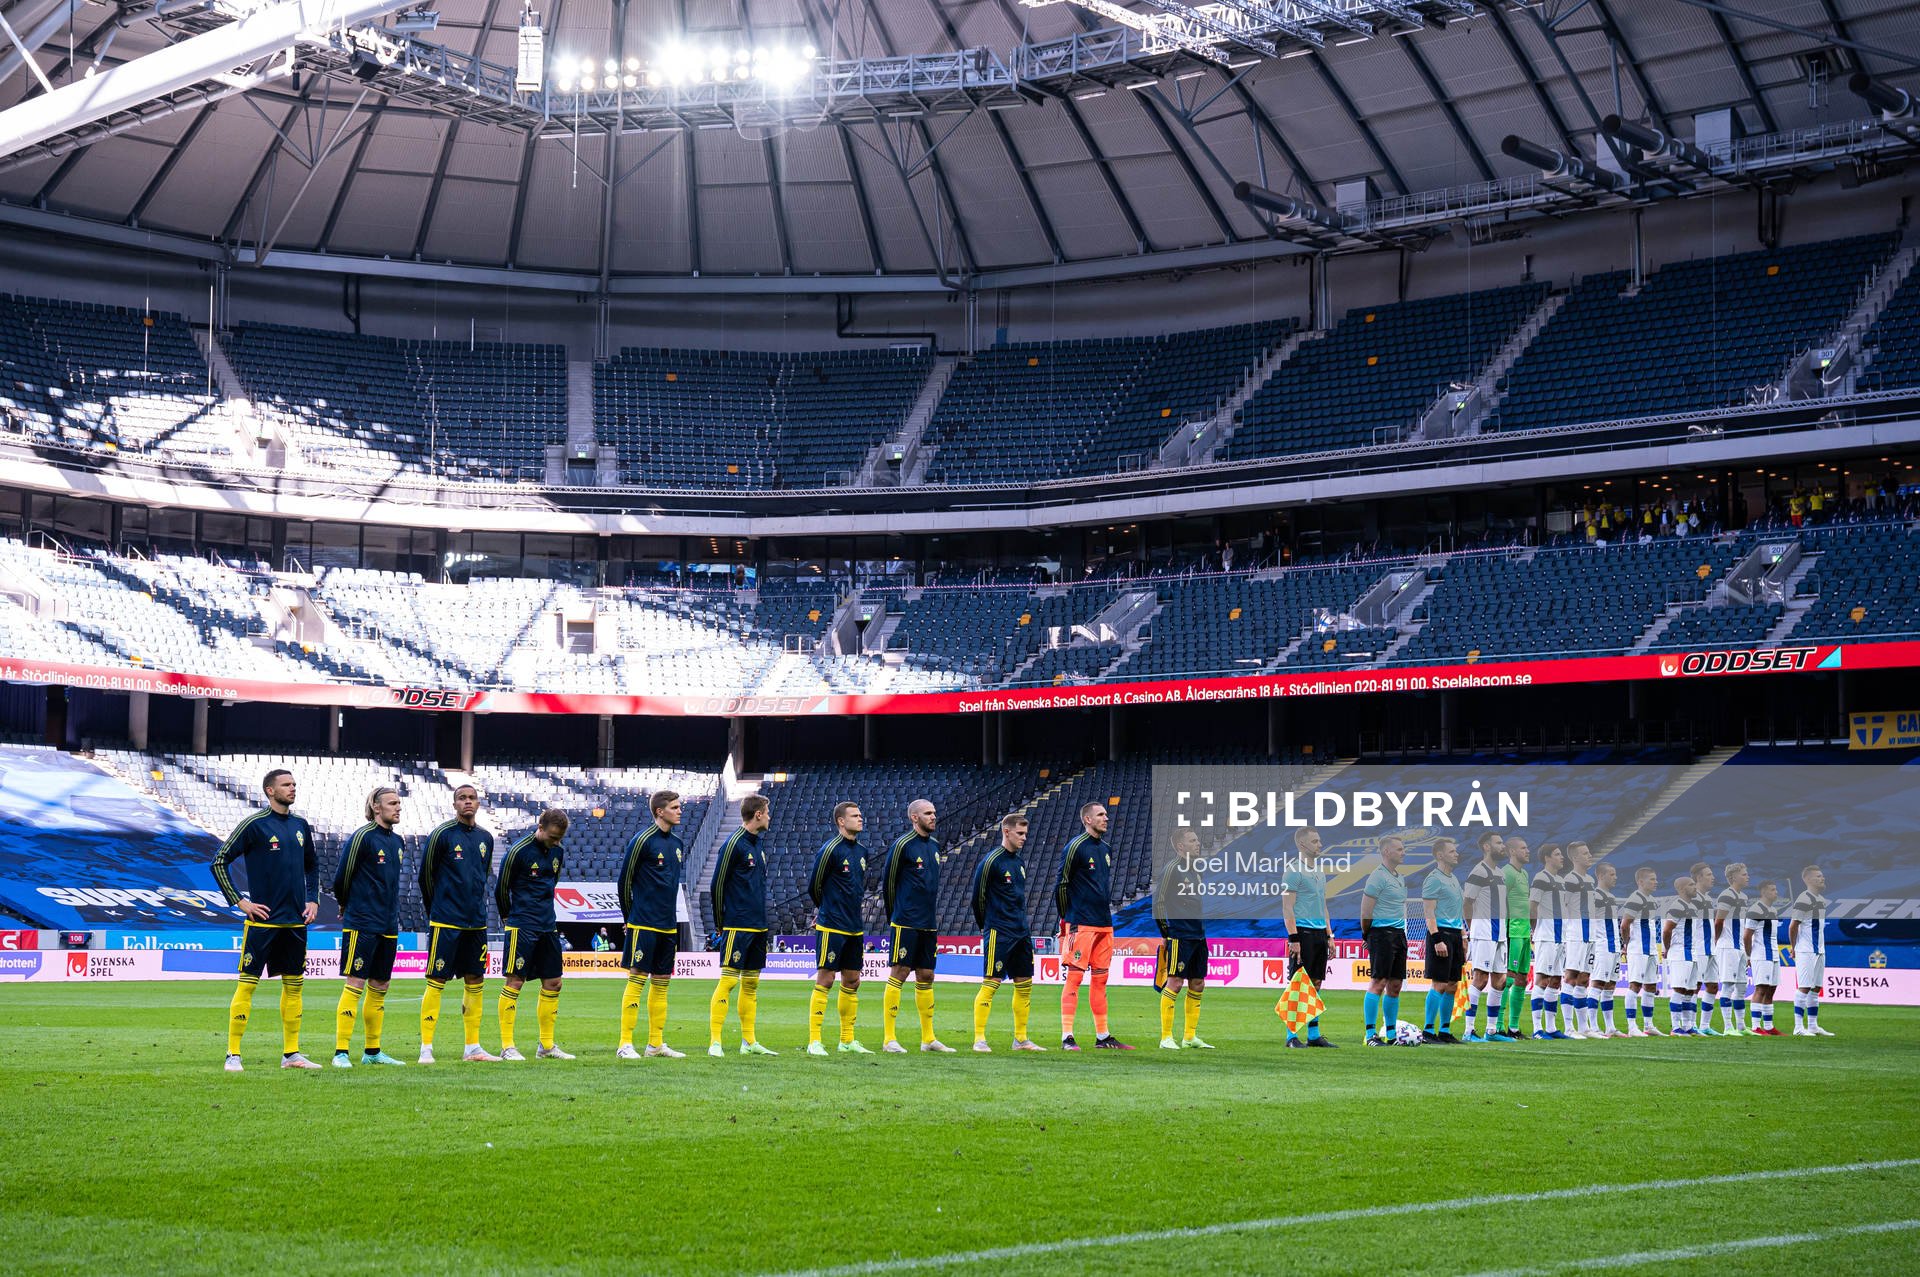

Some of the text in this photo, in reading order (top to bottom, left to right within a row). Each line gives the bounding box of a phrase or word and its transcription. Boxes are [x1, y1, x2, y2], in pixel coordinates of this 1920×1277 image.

[1682, 647, 1817, 675] ODDSET
[959, 700, 983, 712] Spel
[985, 698, 1005, 711] från
[1007, 696, 1051, 710] Svenska
[1053, 694, 1078, 708] Spel
[1080, 693, 1111, 706] Sport
[1114, 694, 1121, 704] &
[1124, 691, 1163, 704] Casino
[1259, 685, 1270, 697] 18
[1432, 673, 1532, 689] Spelalagom.se
[703, 696, 809, 714] ODDSET
[90, 957, 135, 967] SVENSKA
[305, 957, 338, 967] SVENSK
[677, 959, 712, 967] SVENSKA
[90, 968, 114, 977] SPEL
[304, 967, 325, 976] SPEL
[676, 968, 695, 976] SPEL
[1129, 962, 1154, 976] Heja
[1828, 976, 1889, 988] SVENSKA
[1828, 988, 1861, 998] SPEL
